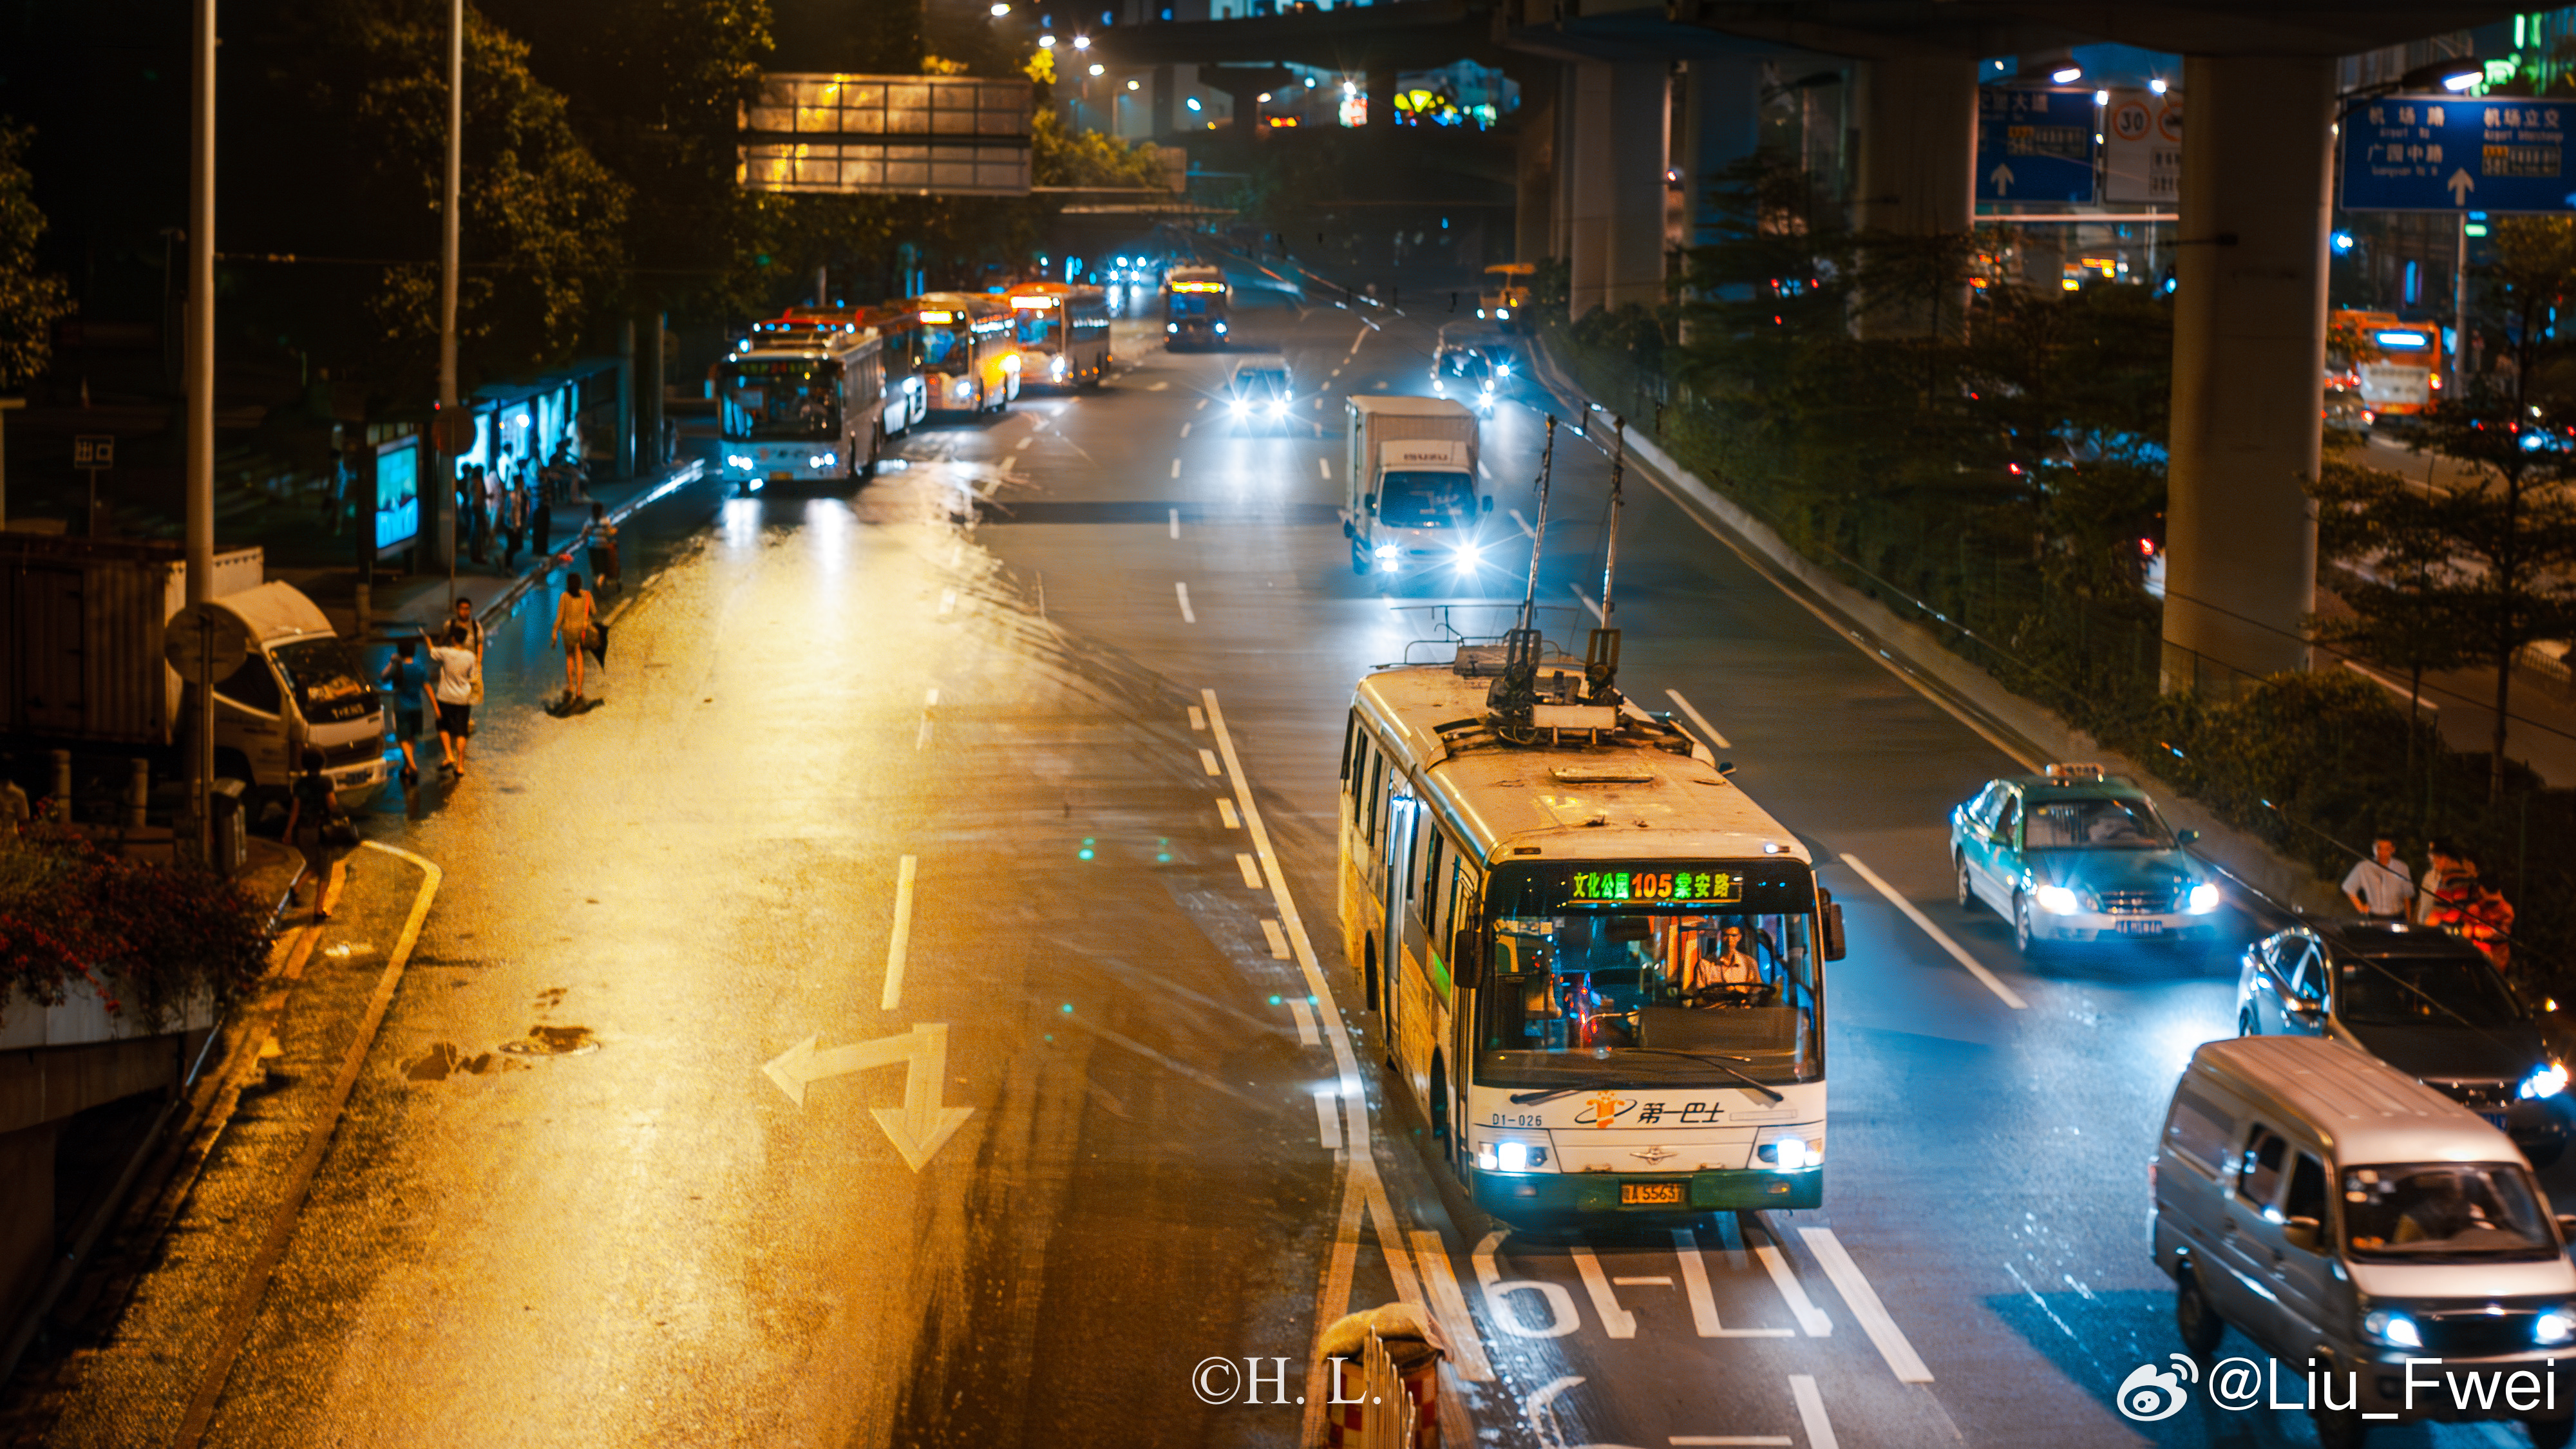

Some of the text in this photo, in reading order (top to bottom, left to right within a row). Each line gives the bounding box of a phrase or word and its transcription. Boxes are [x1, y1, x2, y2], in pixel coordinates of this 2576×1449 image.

[75, 442, 113, 461] 出口
[1573, 872, 1629, 899] 文化公园
[1632, 873, 1672, 898] 105
[1493, 1113, 1542, 1126] D1-026
[1637, 1102, 1724, 1124] 第一巴士
